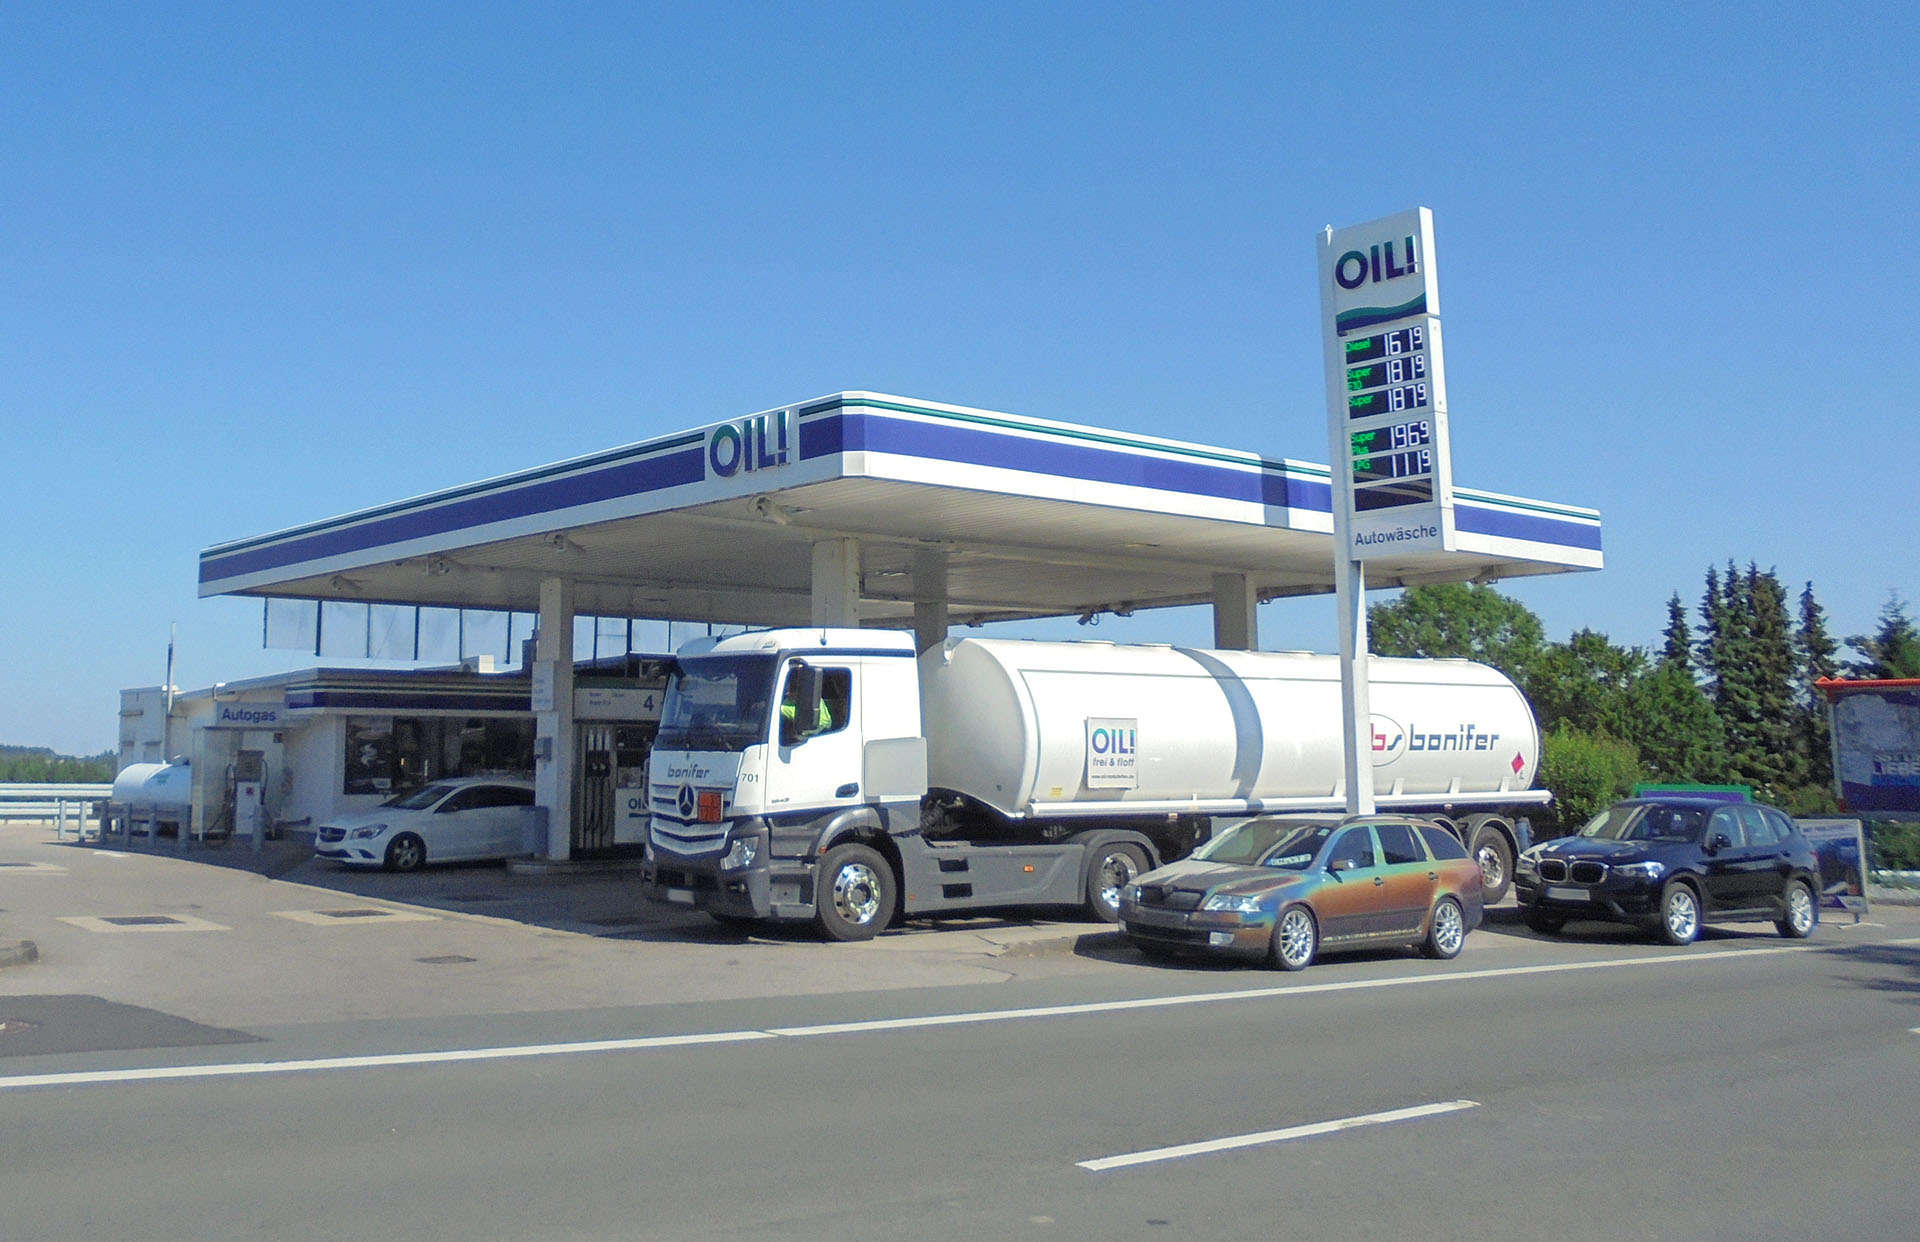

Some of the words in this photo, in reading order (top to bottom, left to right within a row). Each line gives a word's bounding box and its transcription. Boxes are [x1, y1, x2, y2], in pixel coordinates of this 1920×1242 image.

[1335, 235, 1416, 290] OIL!
[1345, 338, 1371, 352] Diesel
[1347, 367, 1372, 379] Super
[1347, 380, 1363, 391] E10
[1349, 395, 1374, 407] Super
[1388, 383, 1427, 412] 1879
[1351, 432, 1376, 443] Super
[1390, 421, 1429, 449] 1969
[710, 410, 788, 477] OIL!
[1353, 445, 1369, 456] Plus
[1353, 459, 1371, 471] LPG
[1355, 525, 1437, 545] Autowäsche
[643, 694, 655, 712] 4
[221, 708, 277, 723] Autogas
[1091, 728, 1135, 754] OIL!
[1409, 723, 1500, 751] bonifer
[667, 763, 710, 778] bonifer
[741, 773, 759, 783] 701
